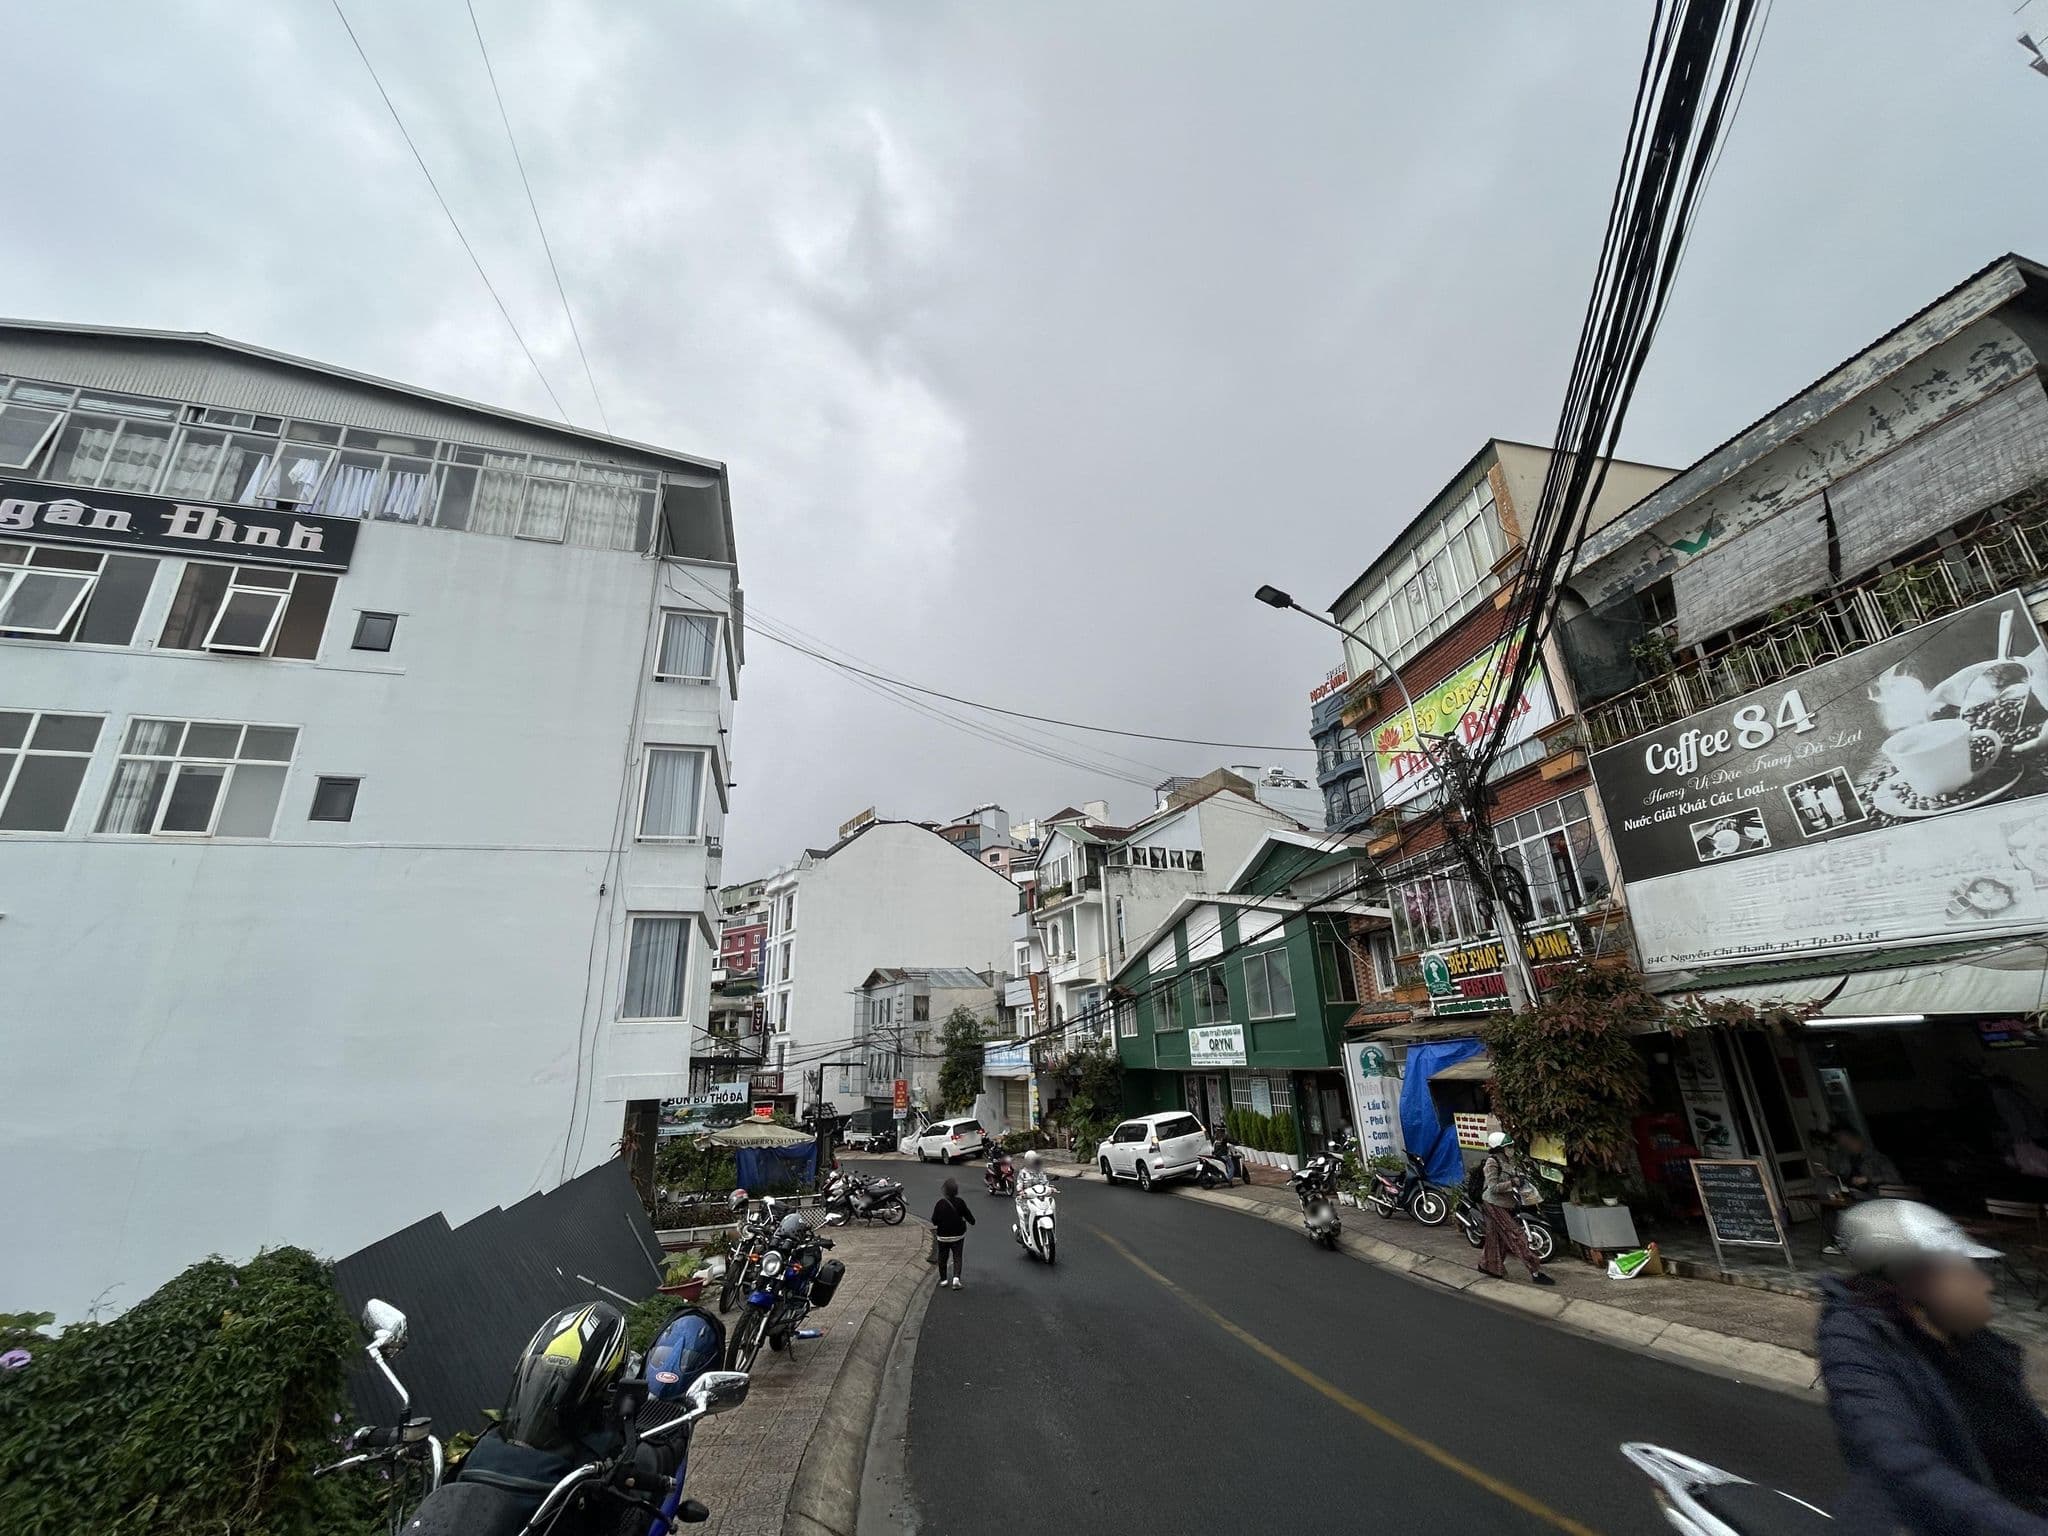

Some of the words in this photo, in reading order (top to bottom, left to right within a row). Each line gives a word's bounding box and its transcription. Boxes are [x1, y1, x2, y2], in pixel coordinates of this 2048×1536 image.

[1441, 670, 1495, 715] Chay
[1645, 729, 1731, 776] Coffee
[1733, 689, 1816, 750] 84
[1624, 814, 1652, 832] Nước
[1654, 807, 1677, 824] Giải
[1679, 799, 1707, 816] Khát
[1710, 790, 1734, 807] Các
[1449, 950, 1469, 975] BẾP
[1469, 945, 1499, 972] CHAY
[1647, 954, 1669, 965] 84C
[1671, 949, 1711, 963] Nguyễn
[1857, 929, 1881, 942] Lạt
